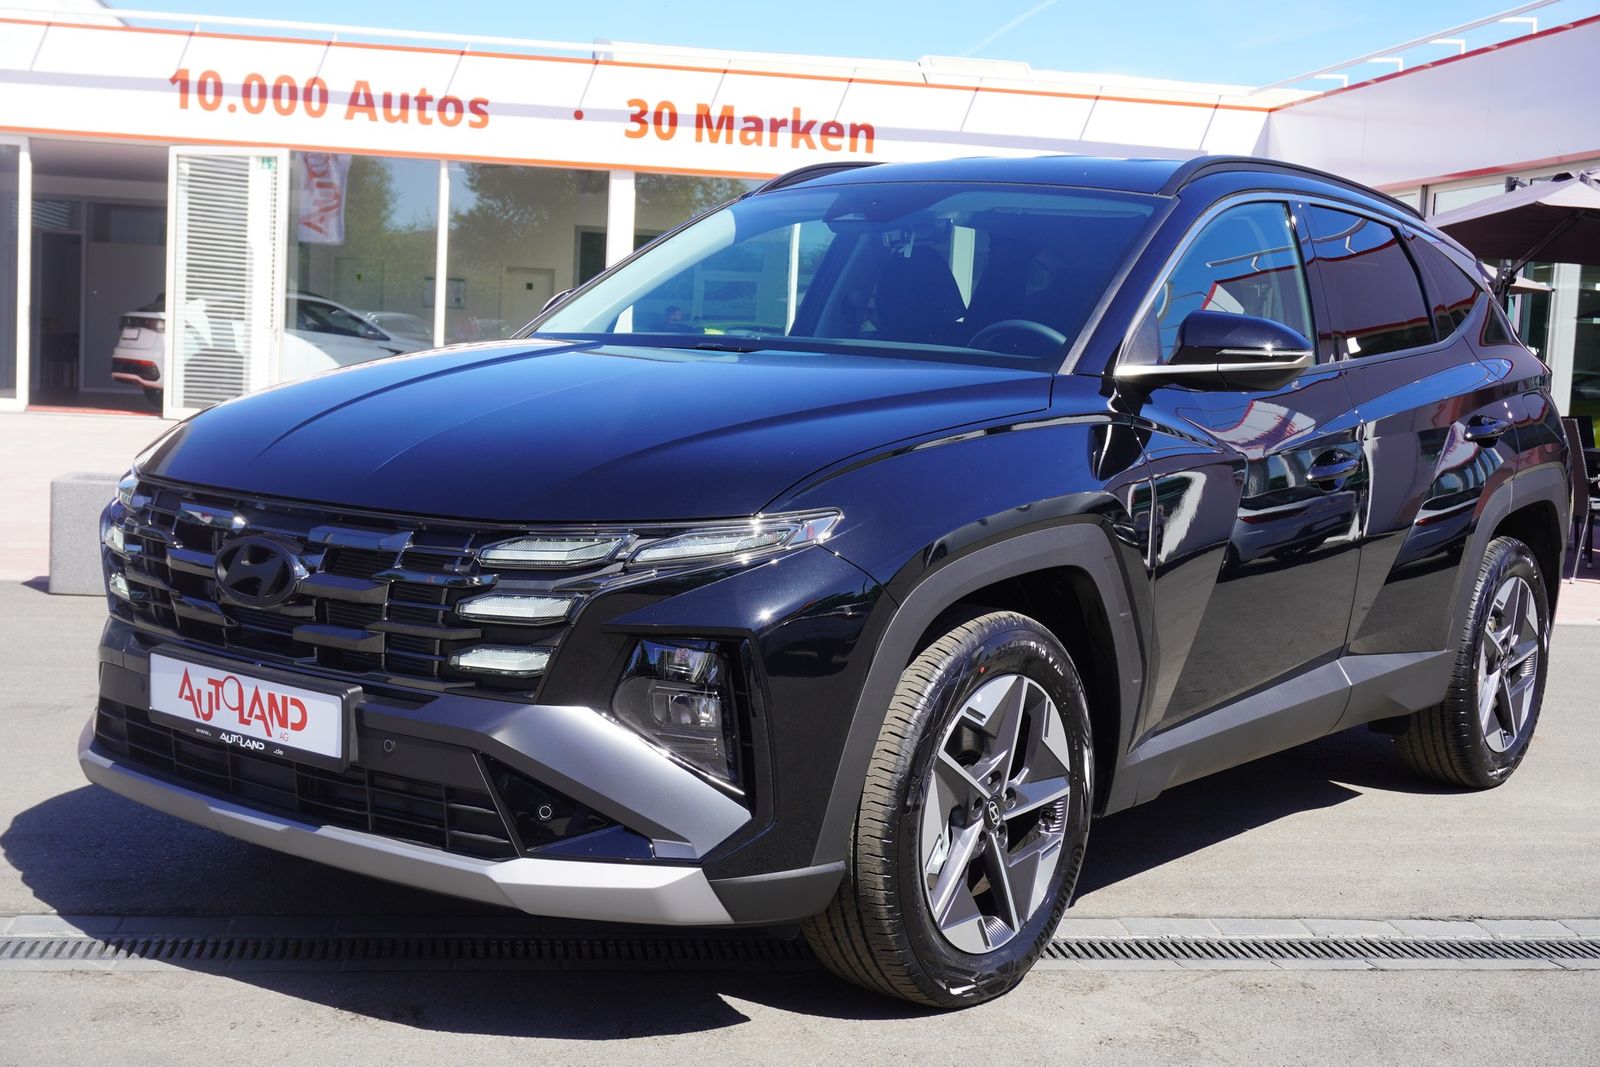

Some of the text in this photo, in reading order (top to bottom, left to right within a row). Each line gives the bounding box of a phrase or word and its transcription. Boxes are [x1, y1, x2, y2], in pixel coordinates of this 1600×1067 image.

[168, 68, 876, 154] 10.000 Autos 30 Marken
[178, 666, 308, 738] AUTOLAND
[219, 732, 265, 750] AUTOLAND
